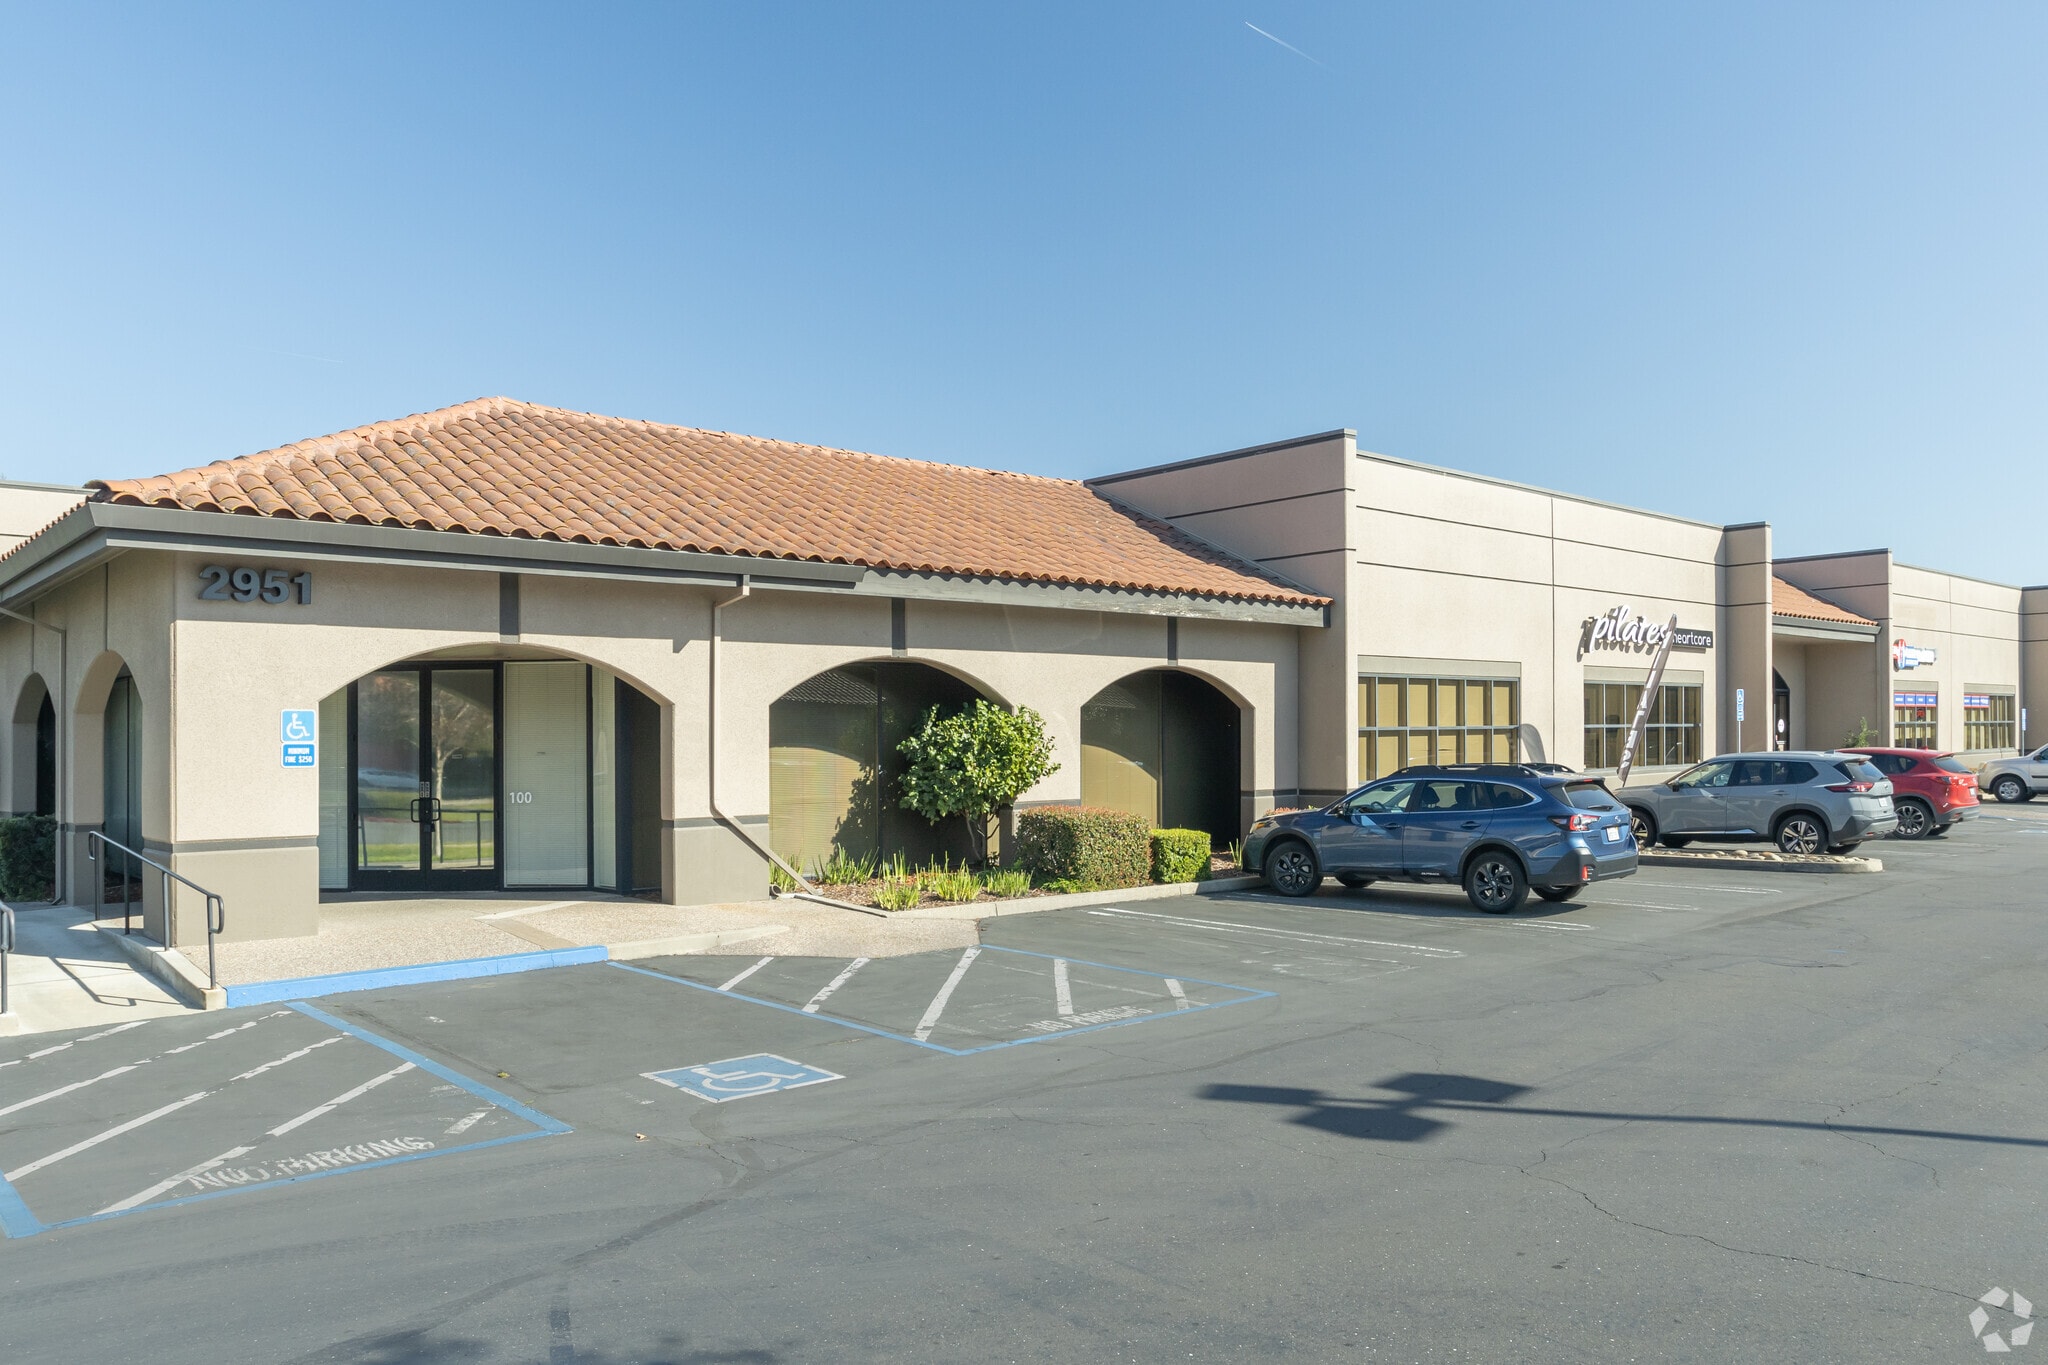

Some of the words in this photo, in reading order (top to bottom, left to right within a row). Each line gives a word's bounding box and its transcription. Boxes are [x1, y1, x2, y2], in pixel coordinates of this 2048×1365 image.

[199, 565, 312, 605] 2951
[1589, 604, 1669, 654] pilates
[509, 791, 532, 804] 100
